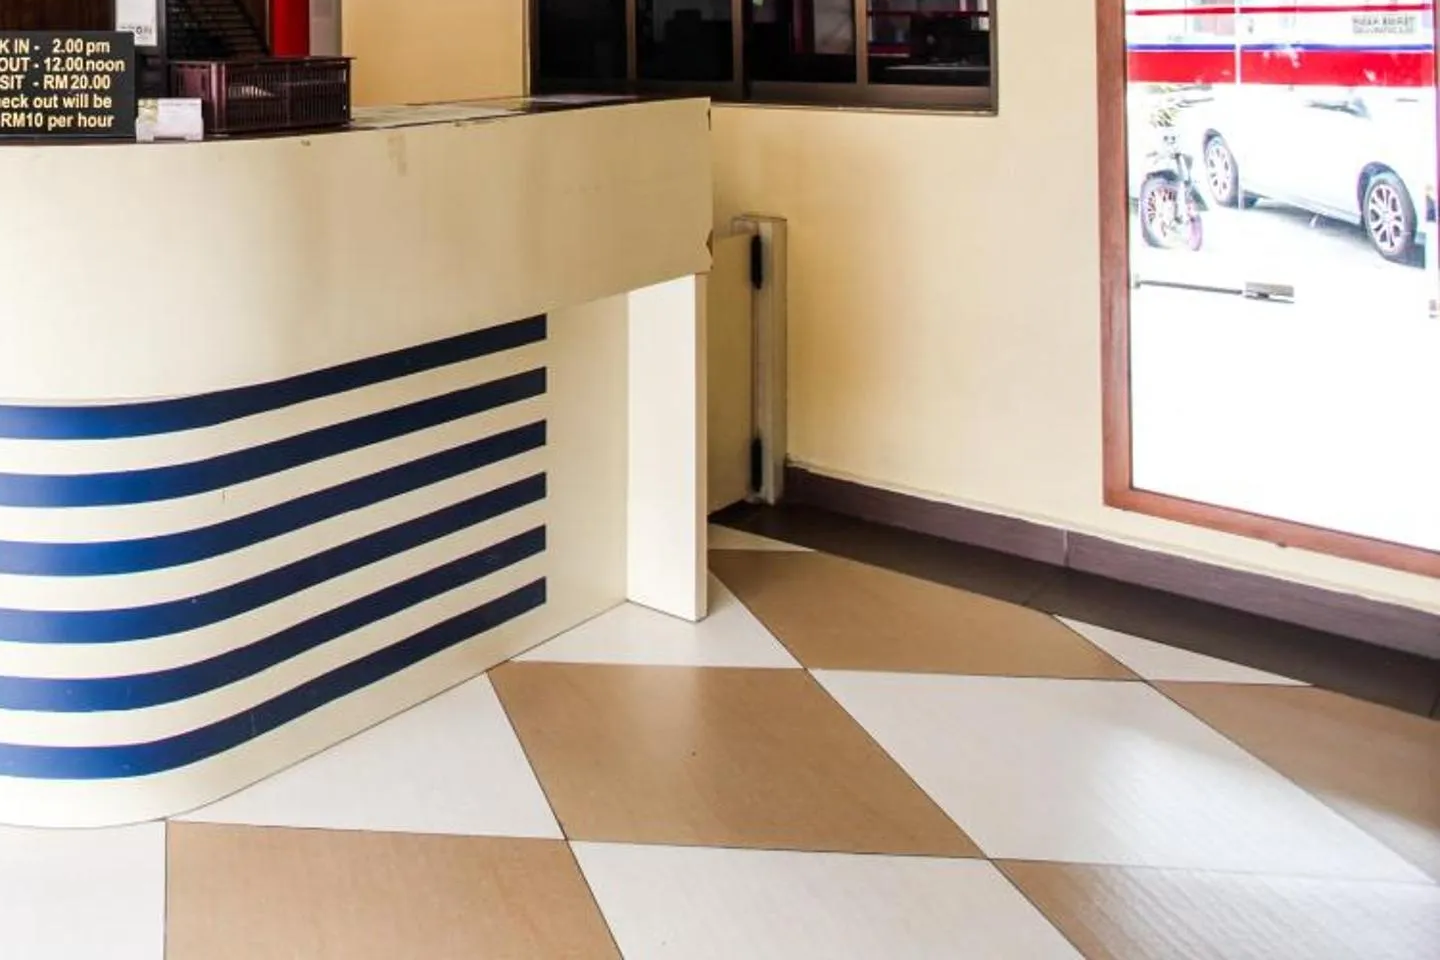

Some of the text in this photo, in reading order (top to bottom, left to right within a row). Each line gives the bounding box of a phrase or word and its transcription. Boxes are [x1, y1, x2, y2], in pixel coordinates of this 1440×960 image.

[14, 39, 30, 54] IN
[52, 39, 83, 54] 2.00
[86, 41, 111, 56] pm
[43, 57, 83, 72] 12.00
[85, 59, 125, 72] noon
[43, 75, 68, 90] RM
[33, 95, 59, 108] out
[62, 93, 89, 108] will
[93, 93, 112, 108] be
[0, 112, 44, 127] RM10
[47, 114, 74, 131] per
[77, 112, 115, 127] hour
